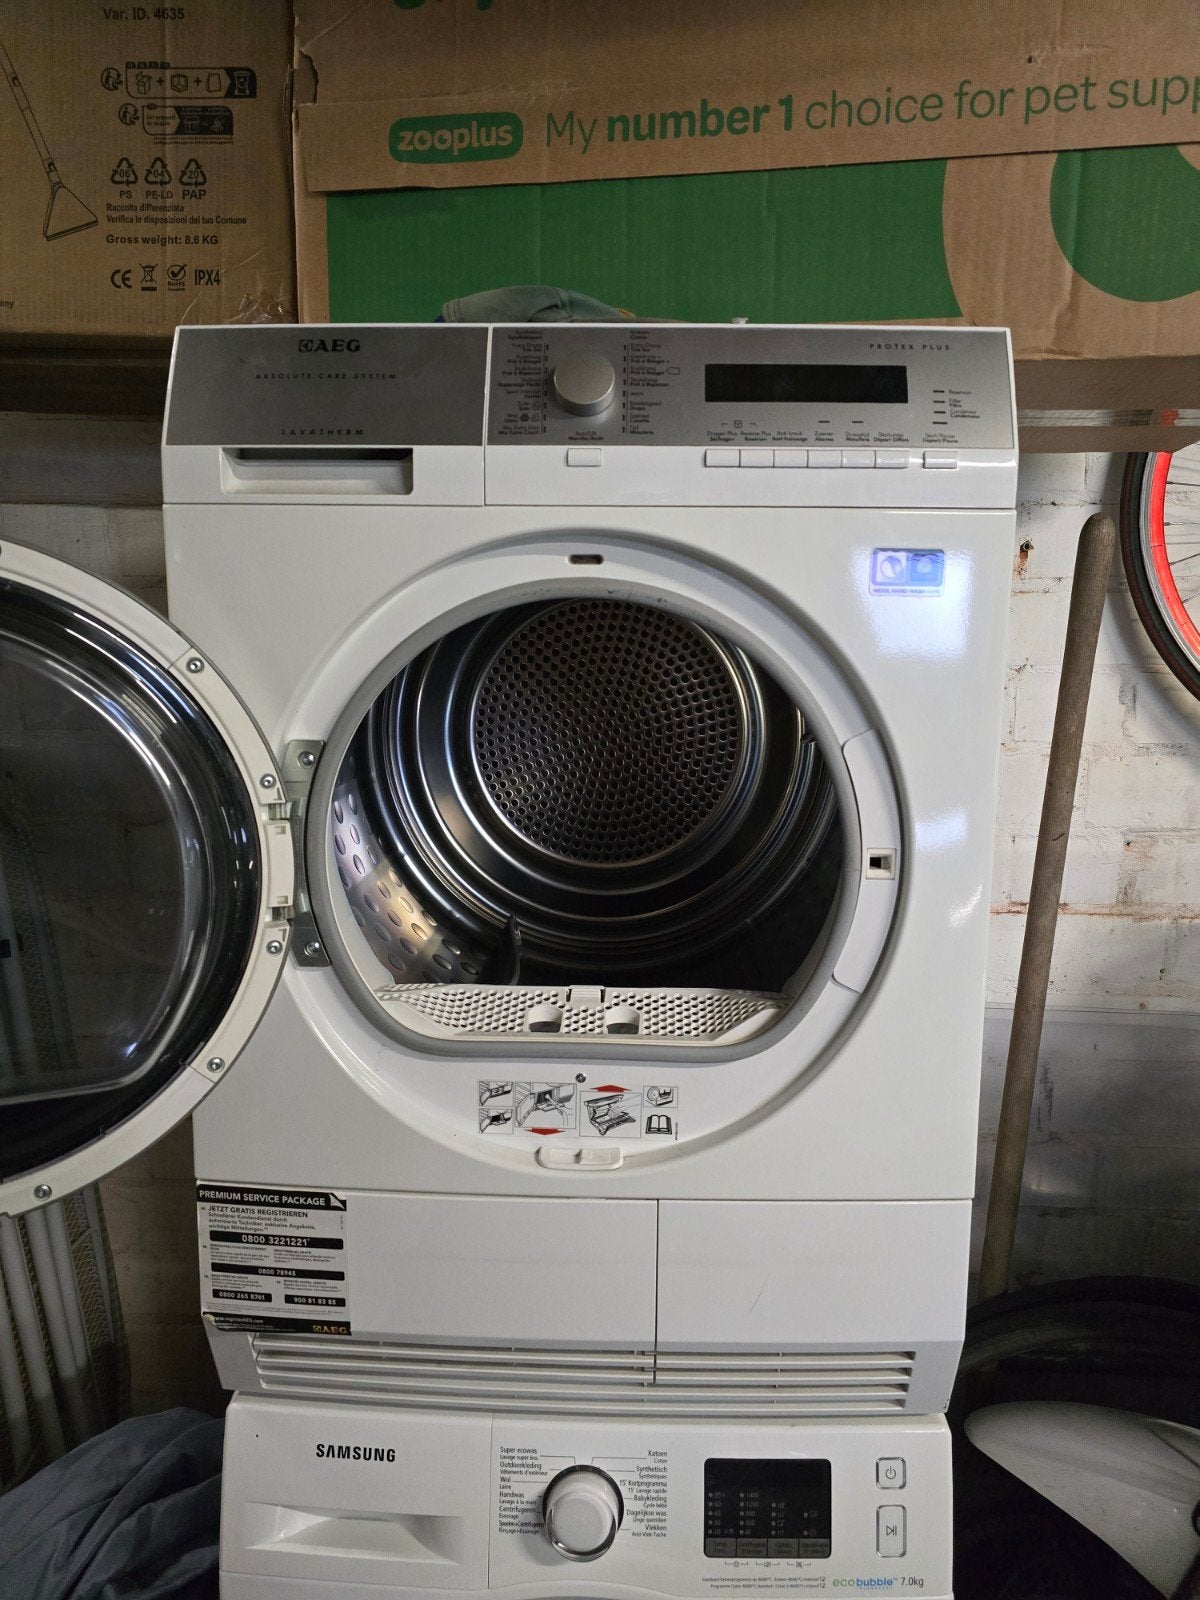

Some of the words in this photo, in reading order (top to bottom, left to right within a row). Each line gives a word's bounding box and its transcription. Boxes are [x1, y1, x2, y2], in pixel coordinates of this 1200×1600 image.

[103, 7, 129, 21] Var.
[132, 7, 150, 21] ID.
[153, 7, 185, 21] 4635
[546, 110, 597, 154] My
[607, 98, 770, 142] number
[779, 94, 794, 132] 1
[805, 87, 944, 130] choice
[954, 79, 1015, 119] for
[1024, 76, 1097, 125] pet
[398, 121, 514, 155] zooplus
[153, 169, 165, 179] 04
[187, 170, 200, 179] 20
[119, 190, 132, 199] PS
[145, 190, 173, 199] PE-LD
[182, 189, 207, 200] PAP
[106, 203, 138, 212] Raccolta
[139, 203, 185, 213] differenziata
[106, 215, 134, 224] Verifica
[135, 215, 142, 224] le
[144, 215, 187, 226] disposizioni
[202, 216, 214, 225] tuo
[216, 216, 247, 225] Comune
[106, 235, 139, 245] Gross
[141, 235, 182, 247] weight:
[184, 235, 201, 245] 8.6
[202, 235, 219, 245] KG
[194, 269, 221, 286] IPX4
[314, 339, 360, 352] AEG
[869, 343, 915, 351] PROTEX
[281, 428, 365, 436] LAVATHERM
[199, 1189, 241, 1201] PREMIUM
[243, 1193, 279, 1203] SERVICE
[281, 1195, 326, 1206] PACKAGE
[230, 1206, 256, 1214] GRATIS
[257, 1208, 309, 1218] REGISTRIEREN
[241, 1234, 265, 1244] 0800
[321, 1326, 348, 1334] AEG
[315, 1443, 396, 1462] SAMSUNG
[500, 1446, 515, 1454] Super
[648, 1449, 668, 1457] Katoen
[500, 1461, 542, 1471] Outdoorkleding
[636, 1465, 668, 1474] Synthetisch
[628, 1480, 668, 1488] Kortprogramma
[633, 1495, 667, 1503] Babykleding
[626, 1509, 654, 1518] Dagelijkse
[900, 1576, 924, 1588] 7.0kg
